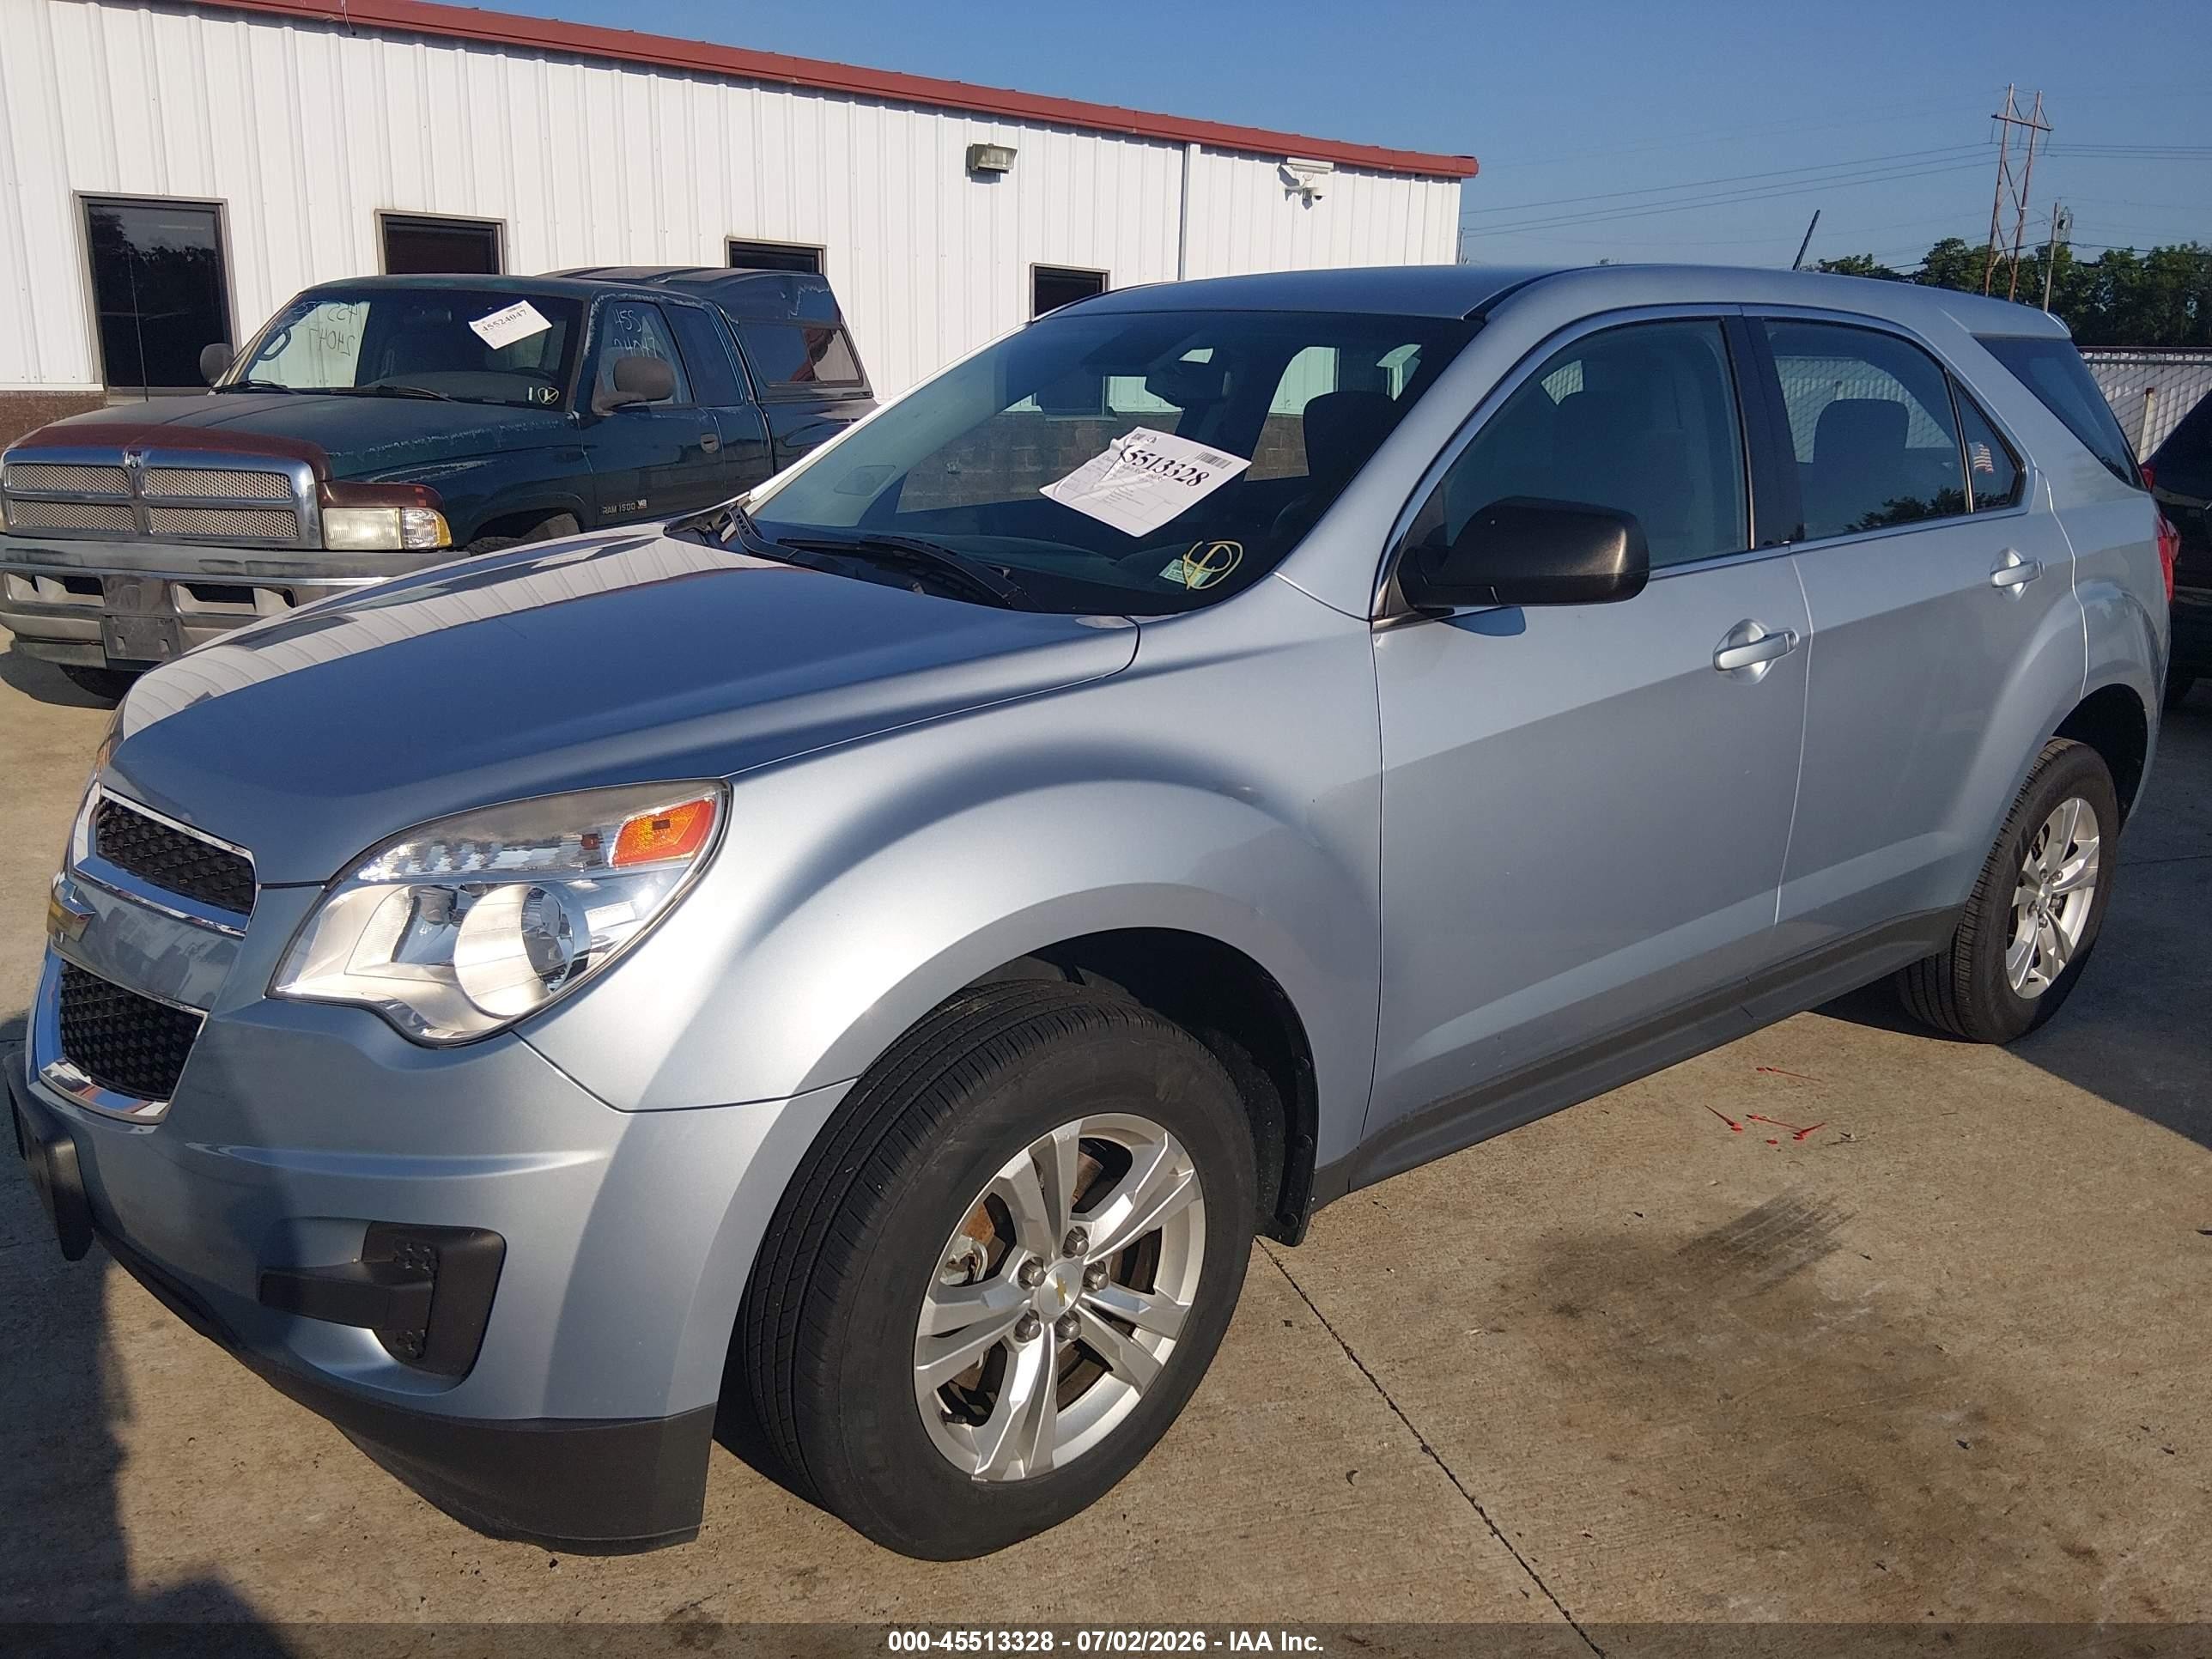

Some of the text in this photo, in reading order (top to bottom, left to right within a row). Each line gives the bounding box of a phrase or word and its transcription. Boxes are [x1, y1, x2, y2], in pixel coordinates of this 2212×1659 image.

[482, 308, 528, 333] 45524047
[602, 505, 618, 515] RAM
[618, 501, 636, 514] 1500
